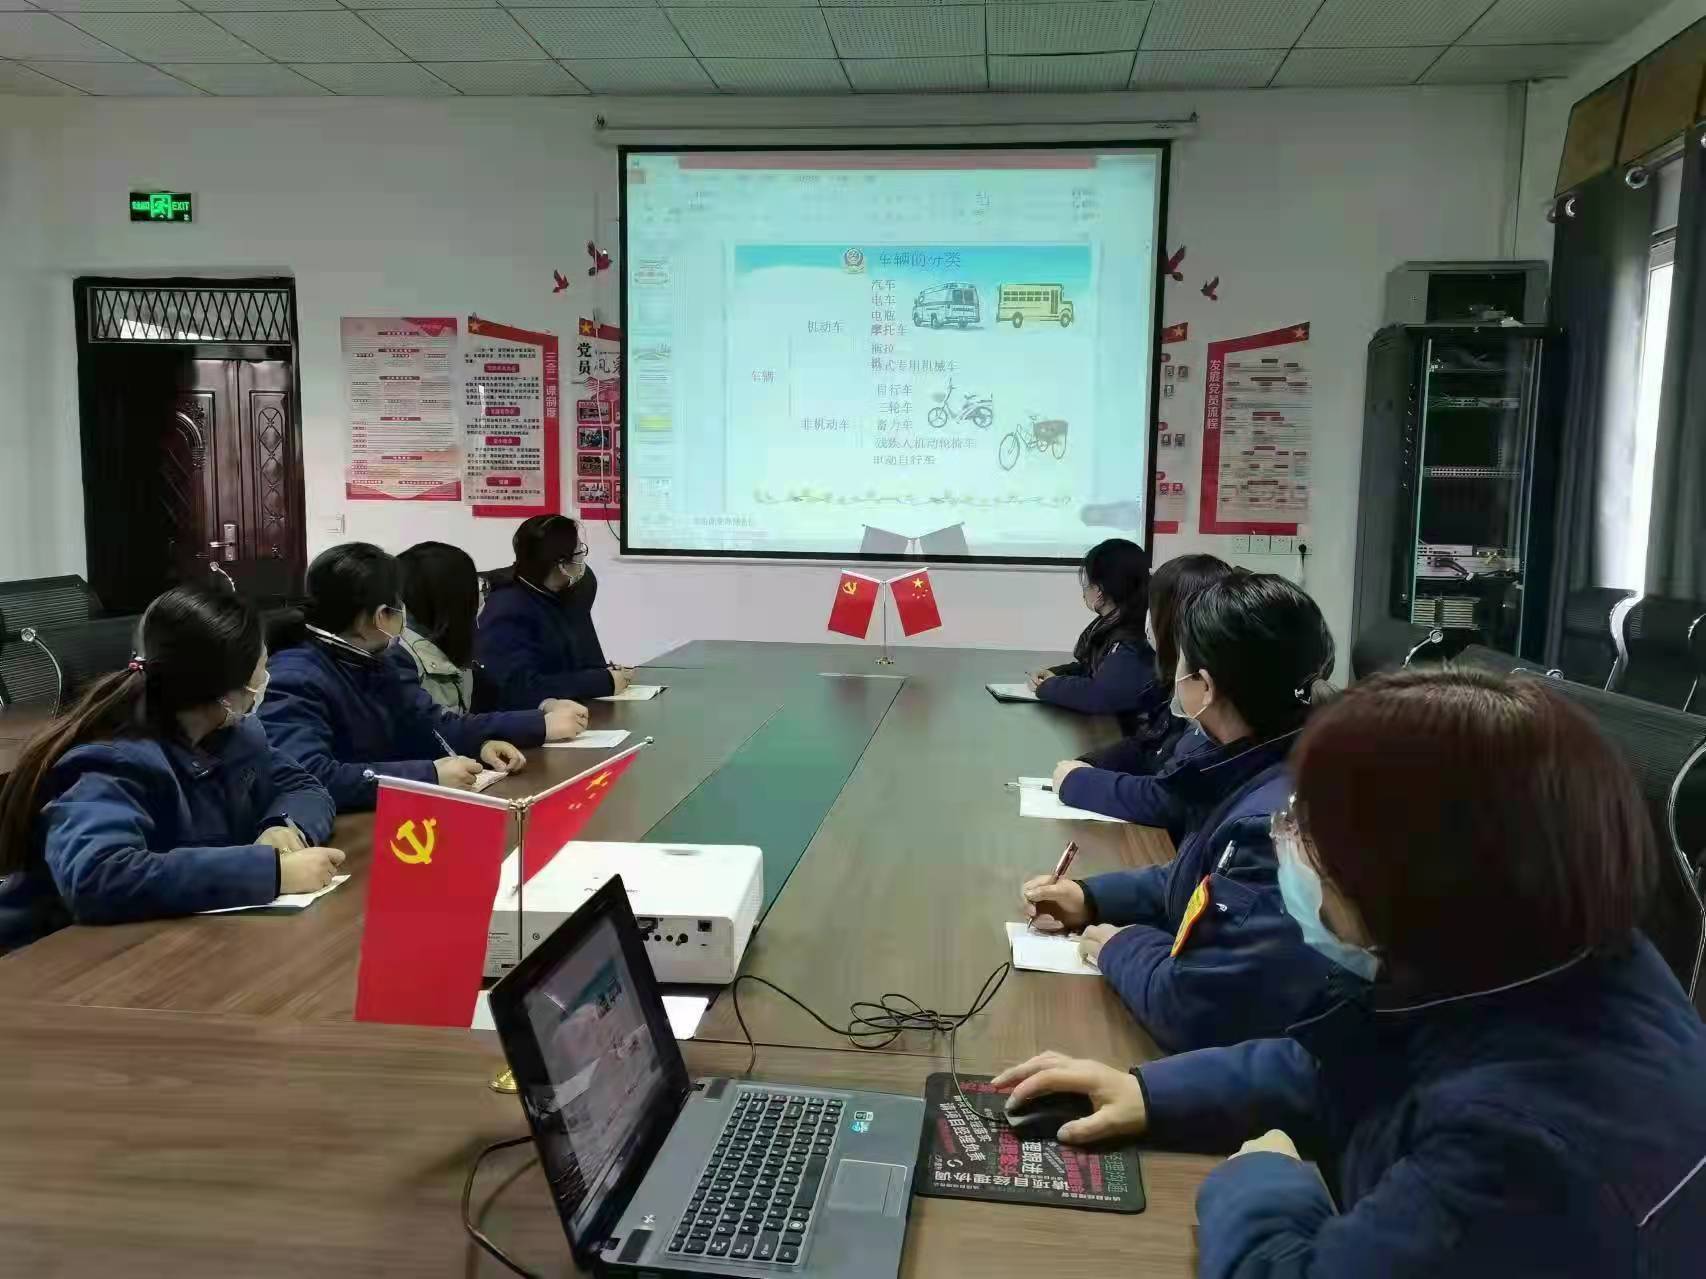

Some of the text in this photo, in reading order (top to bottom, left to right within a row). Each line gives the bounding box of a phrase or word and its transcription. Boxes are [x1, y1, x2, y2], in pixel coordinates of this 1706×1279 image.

[172, 202, 190, 211] EXIT
[879, 251, 961, 269] 车辆的分类
[807, 320, 844, 334] 机动车
[871, 324, 908, 336] 摩托车
[577, 342, 592, 375] 党员
[1206, 359, 1222, 430] 发展党员流程
[801, 418, 849, 432] 非机动车
[934, 1170, 1073, 1191] 请项目经理协调
